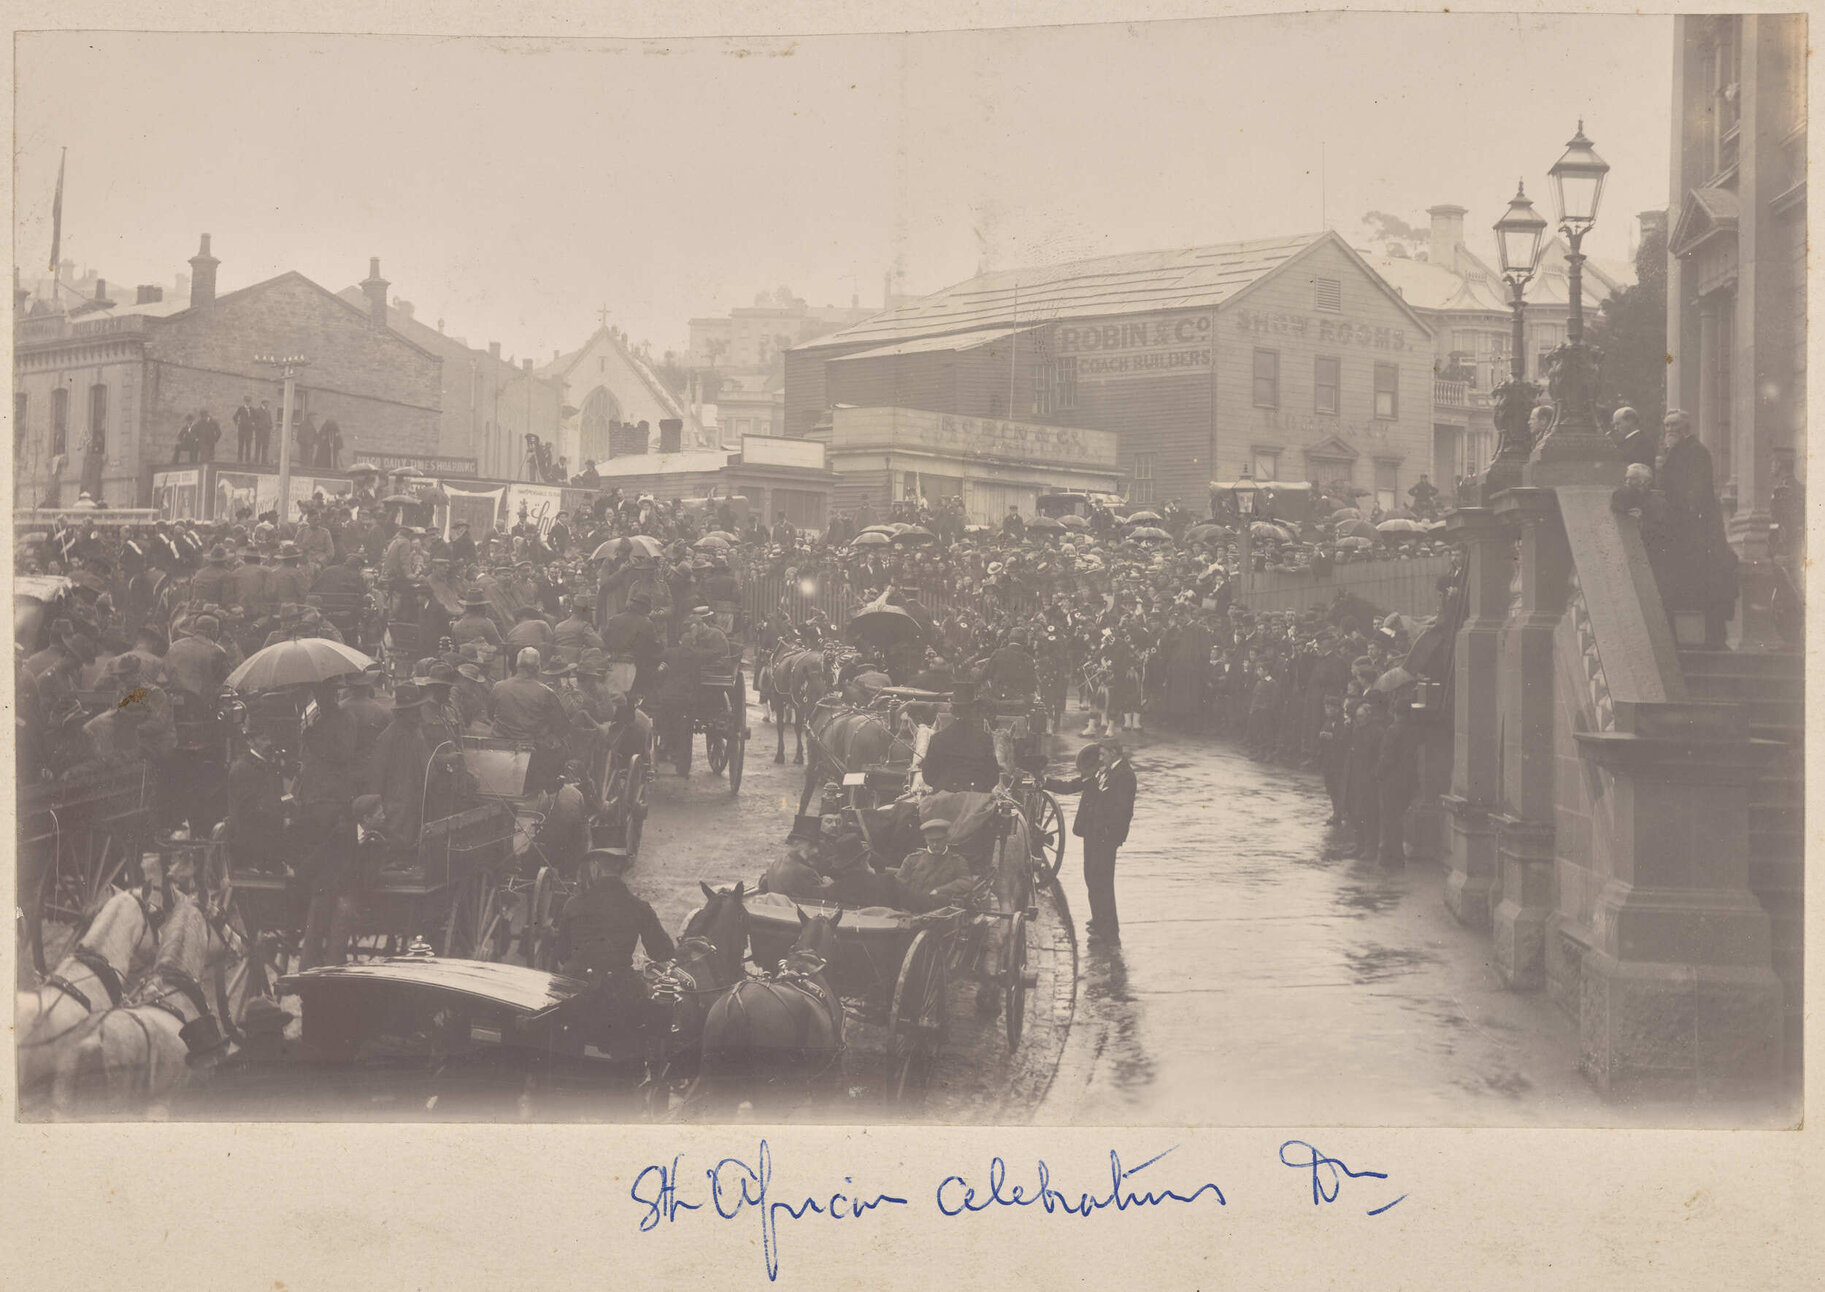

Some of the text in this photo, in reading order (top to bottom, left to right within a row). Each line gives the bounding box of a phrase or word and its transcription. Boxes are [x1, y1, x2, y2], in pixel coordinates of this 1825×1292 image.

[1237, 308, 1307, 335] SHOW
[1062, 322, 1147, 352] ROBIN
[1154, 322, 1169, 345] &
[1079, 349, 1210, 374] COACH BUILDERS
[940, 414, 1027, 441] ROBIN
[384, 457, 408, 469] DAILY
[410, 459, 435, 471] TIMES
